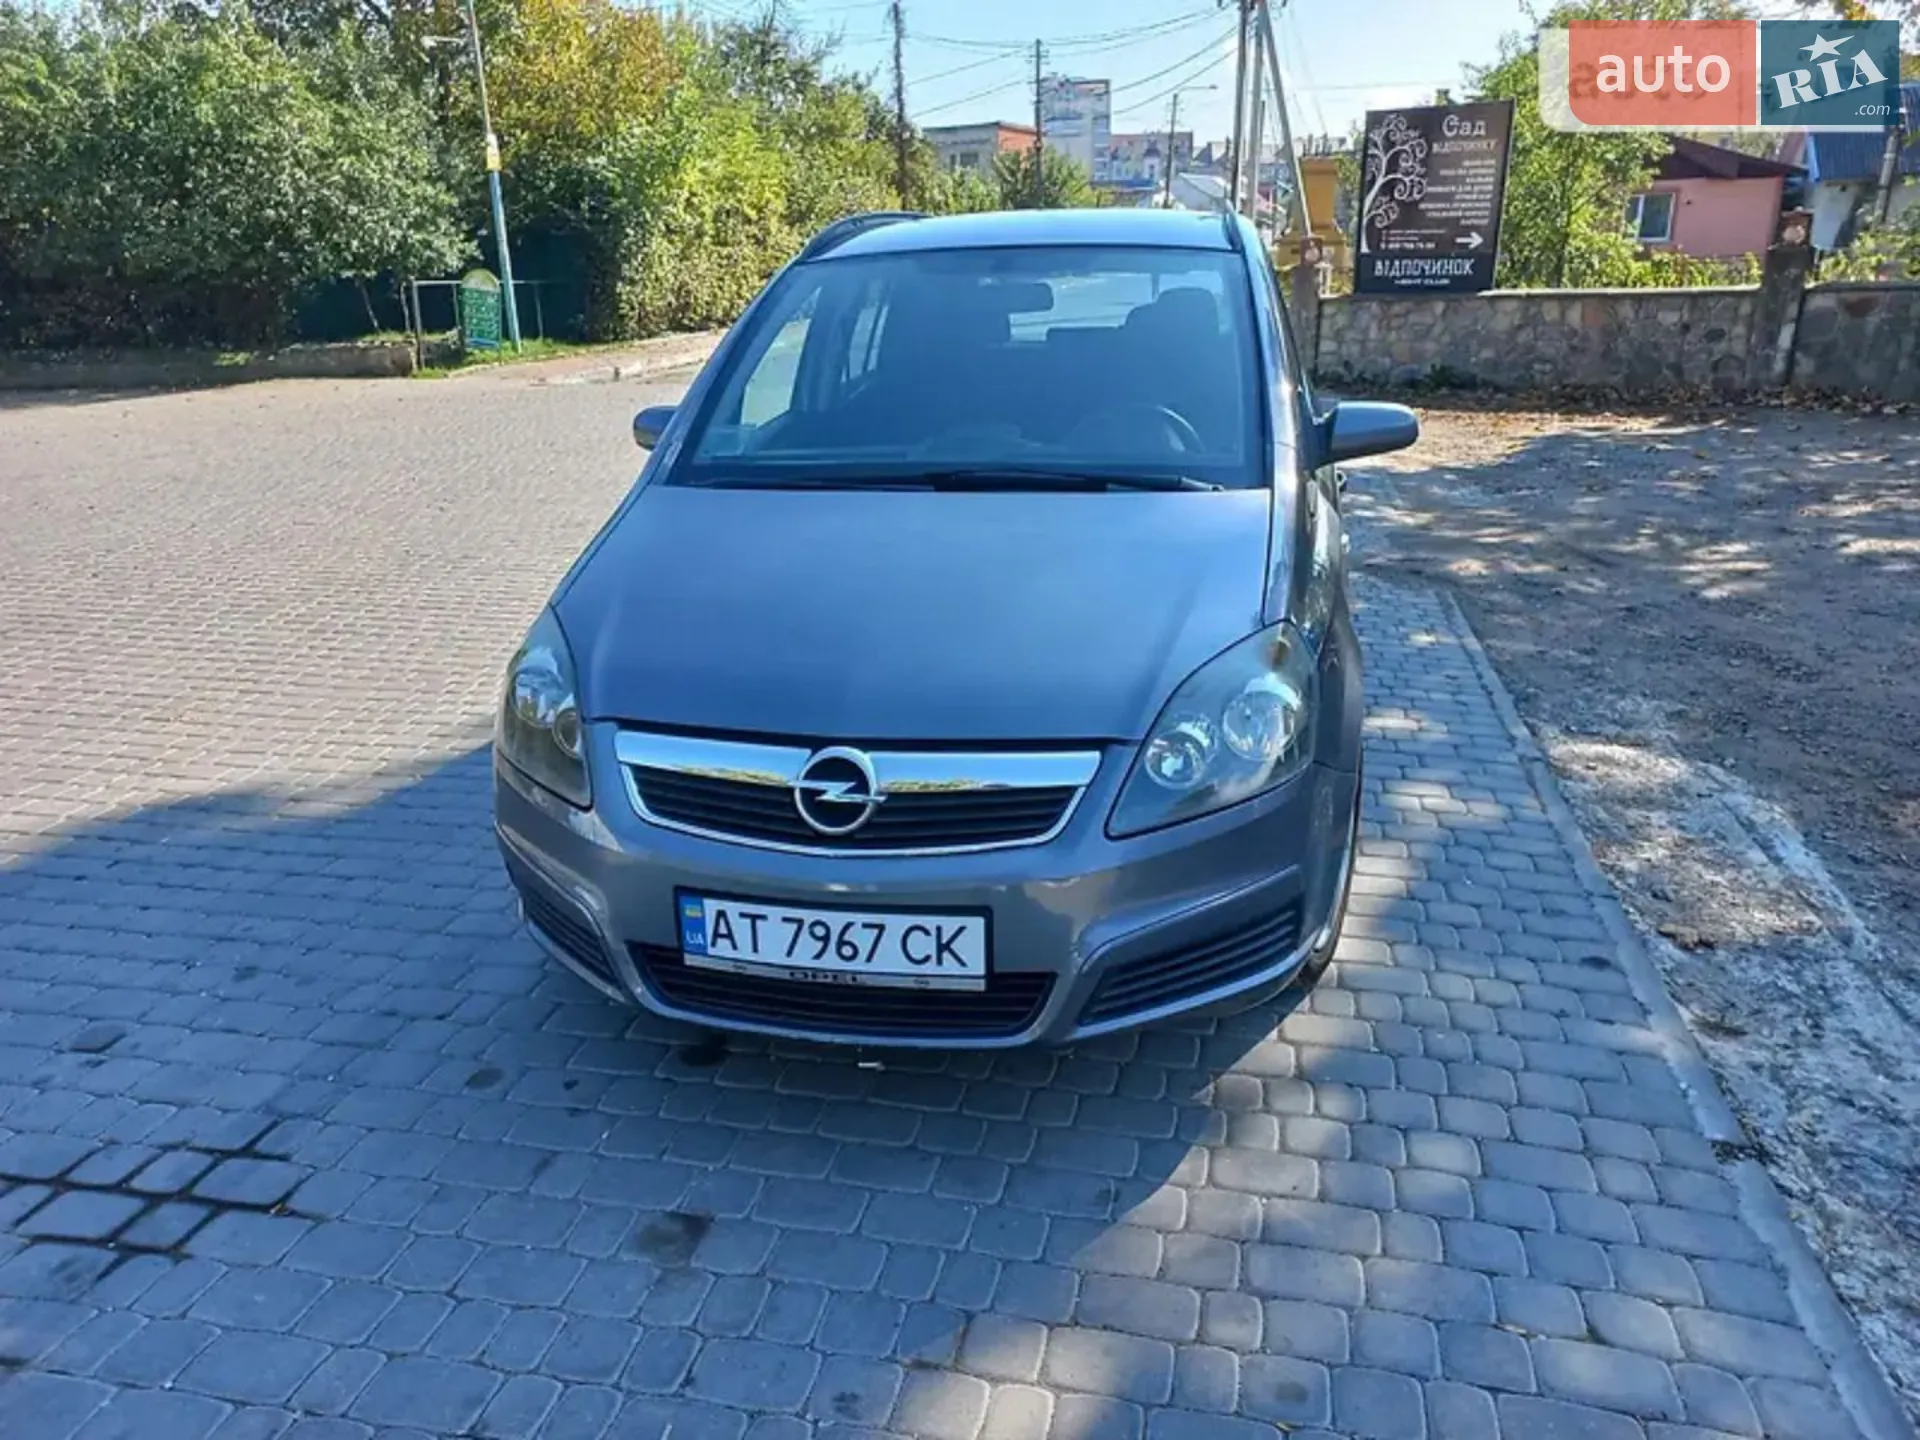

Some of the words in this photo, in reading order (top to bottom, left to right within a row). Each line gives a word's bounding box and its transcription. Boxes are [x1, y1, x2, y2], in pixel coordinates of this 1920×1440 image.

[1441, 114, 1487, 137] Сад
[1373, 258, 1476, 277] ВІДПОЧИНОК
[685, 929, 704, 945] UA
[710, 909, 768, 953] AT
[781, 916, 887, 963] 7967
[900, 924, 969, 968] CK
